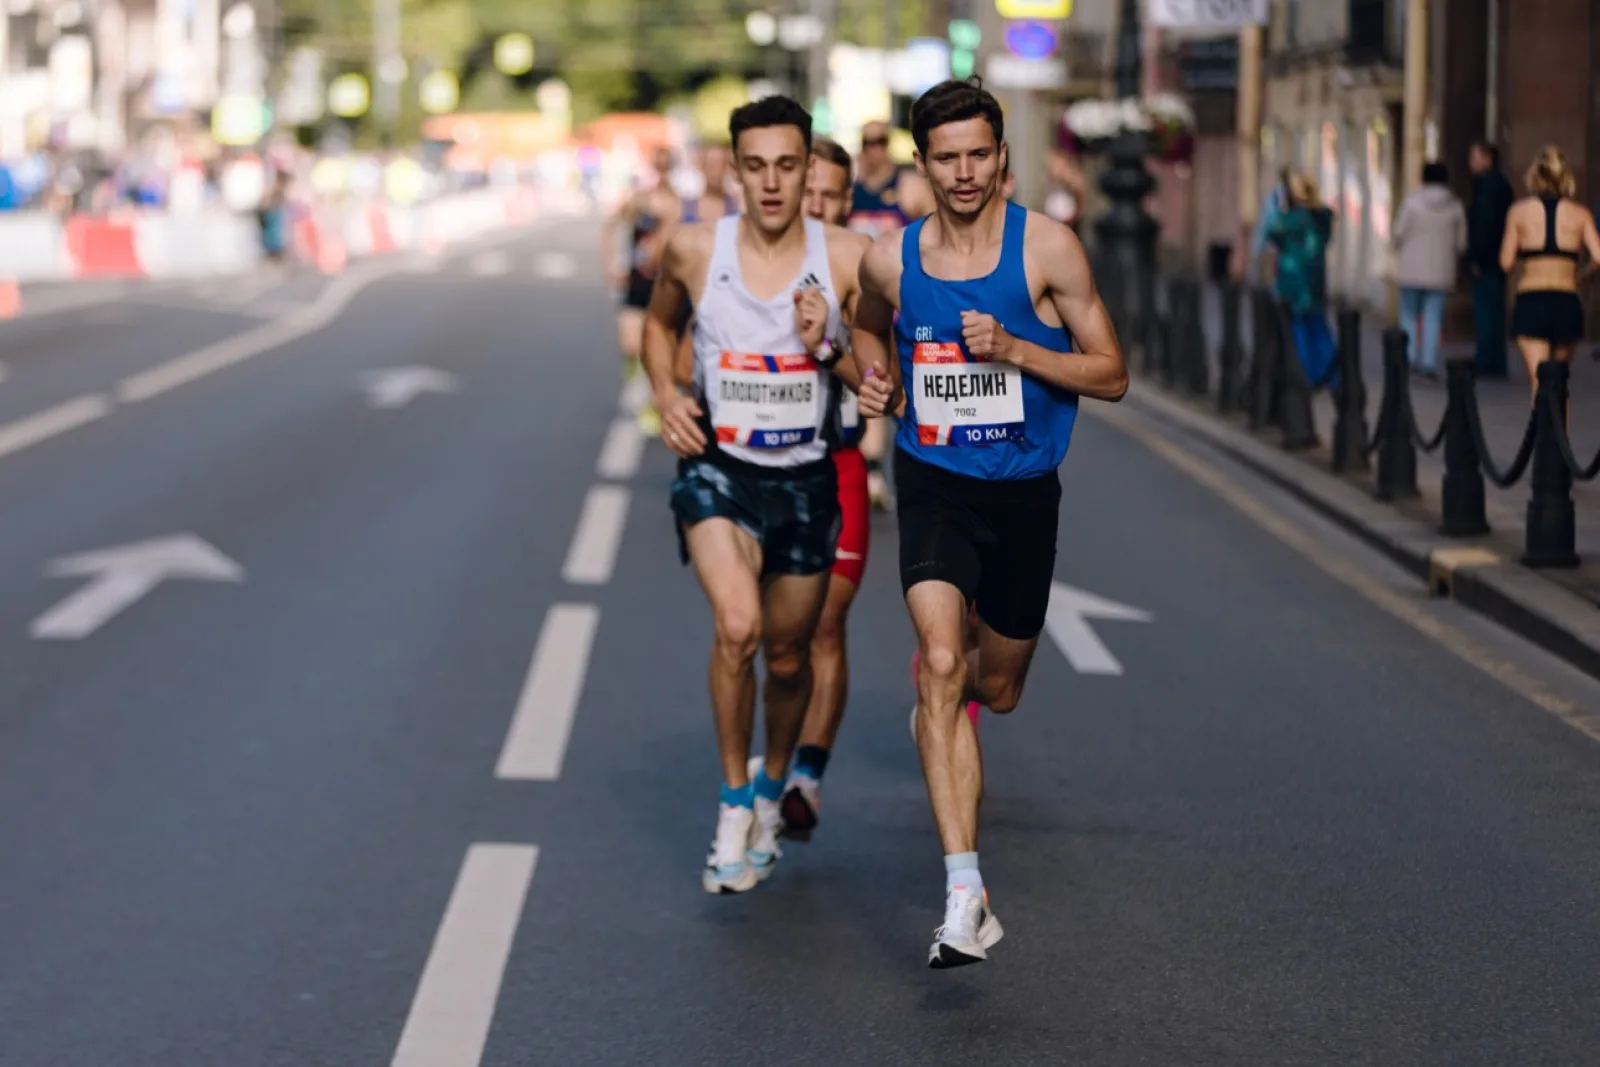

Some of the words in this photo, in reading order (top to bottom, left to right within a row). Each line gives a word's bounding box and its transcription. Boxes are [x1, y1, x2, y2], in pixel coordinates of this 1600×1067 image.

[721, 380, 813, 403] ПЛОХОТНИКОВ
[923, 372, 1007, 402] НЕДЕЛИН
[954, 407, 977, 417] 7002
[763, 432, 780, 445] 10
[966, 430, 982, 442] 10
